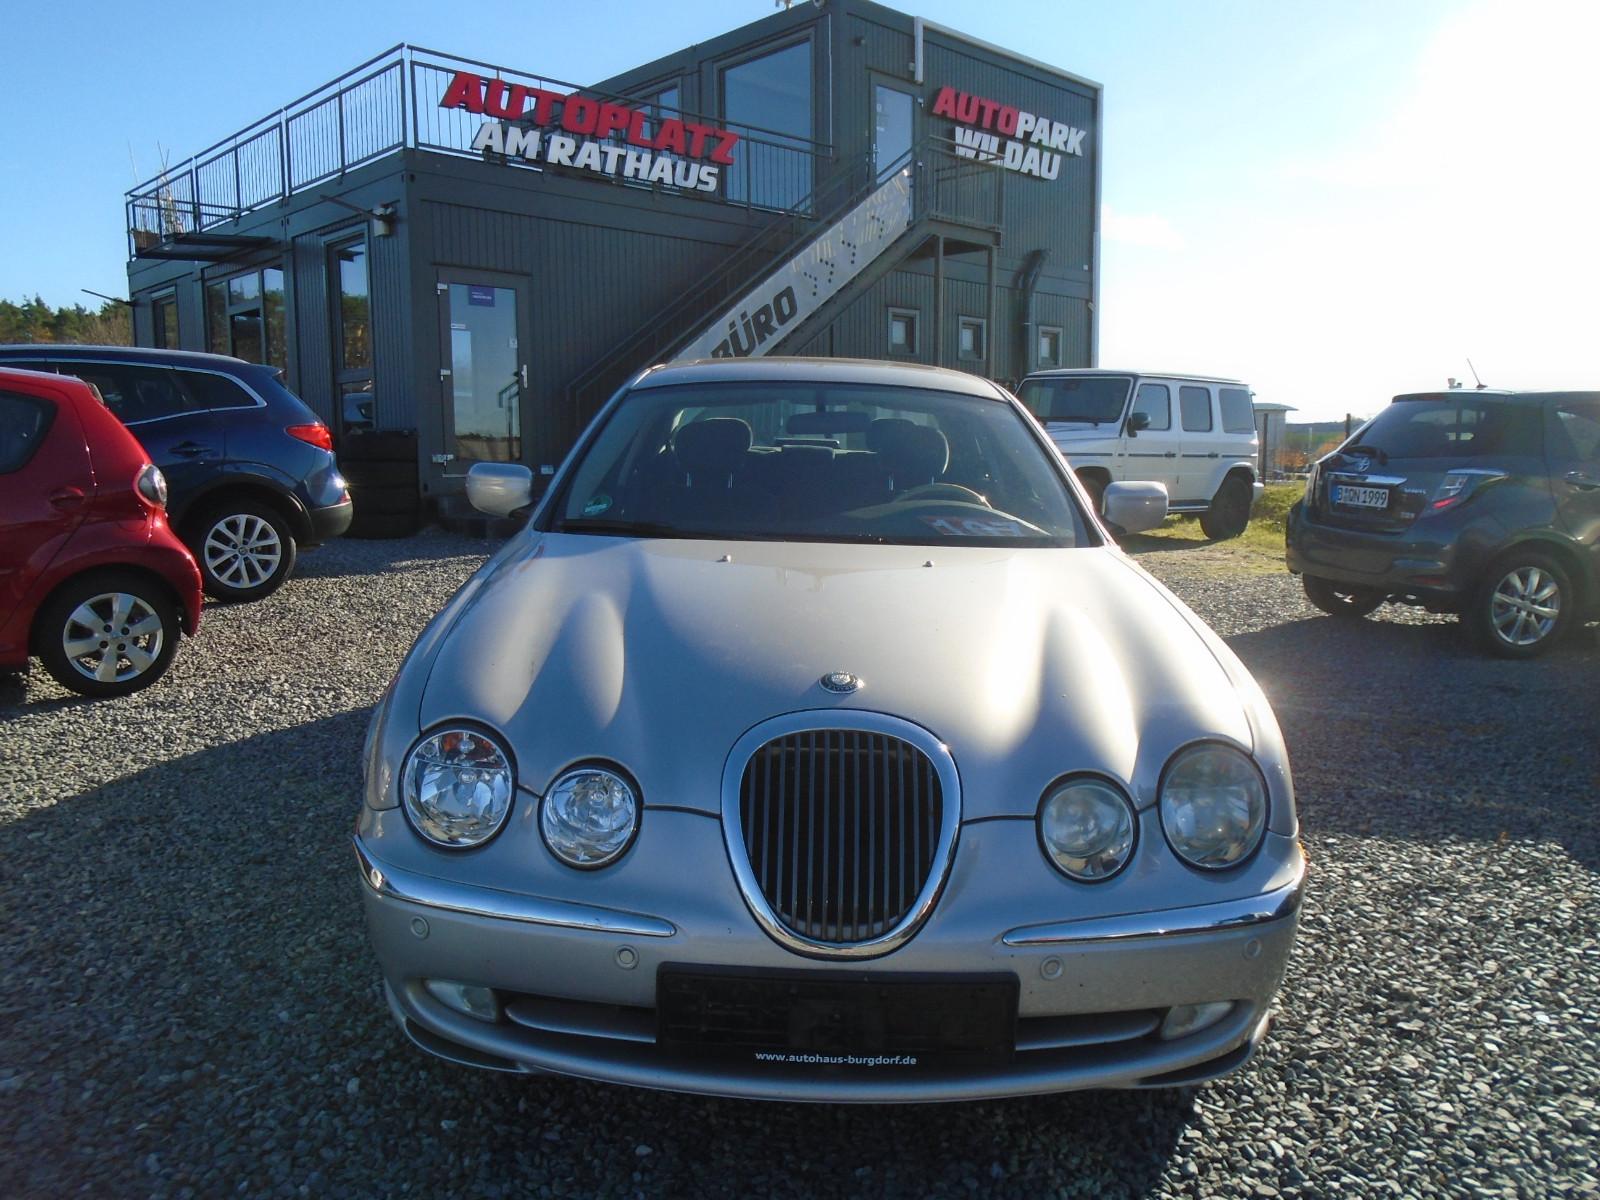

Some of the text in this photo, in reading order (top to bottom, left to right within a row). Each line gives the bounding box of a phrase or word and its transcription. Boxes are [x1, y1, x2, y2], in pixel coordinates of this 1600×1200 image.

[439, 70, 740, 165] AUTOPLATZ
[932, 85, 1087, 157] AUTOPARK
[954, 126, 1062, 181] WILDAU
[470, 121, 720, 193] AM RATHAUS
[755, 1052, 917, 1067] www.autohaus-burgdorf.de
